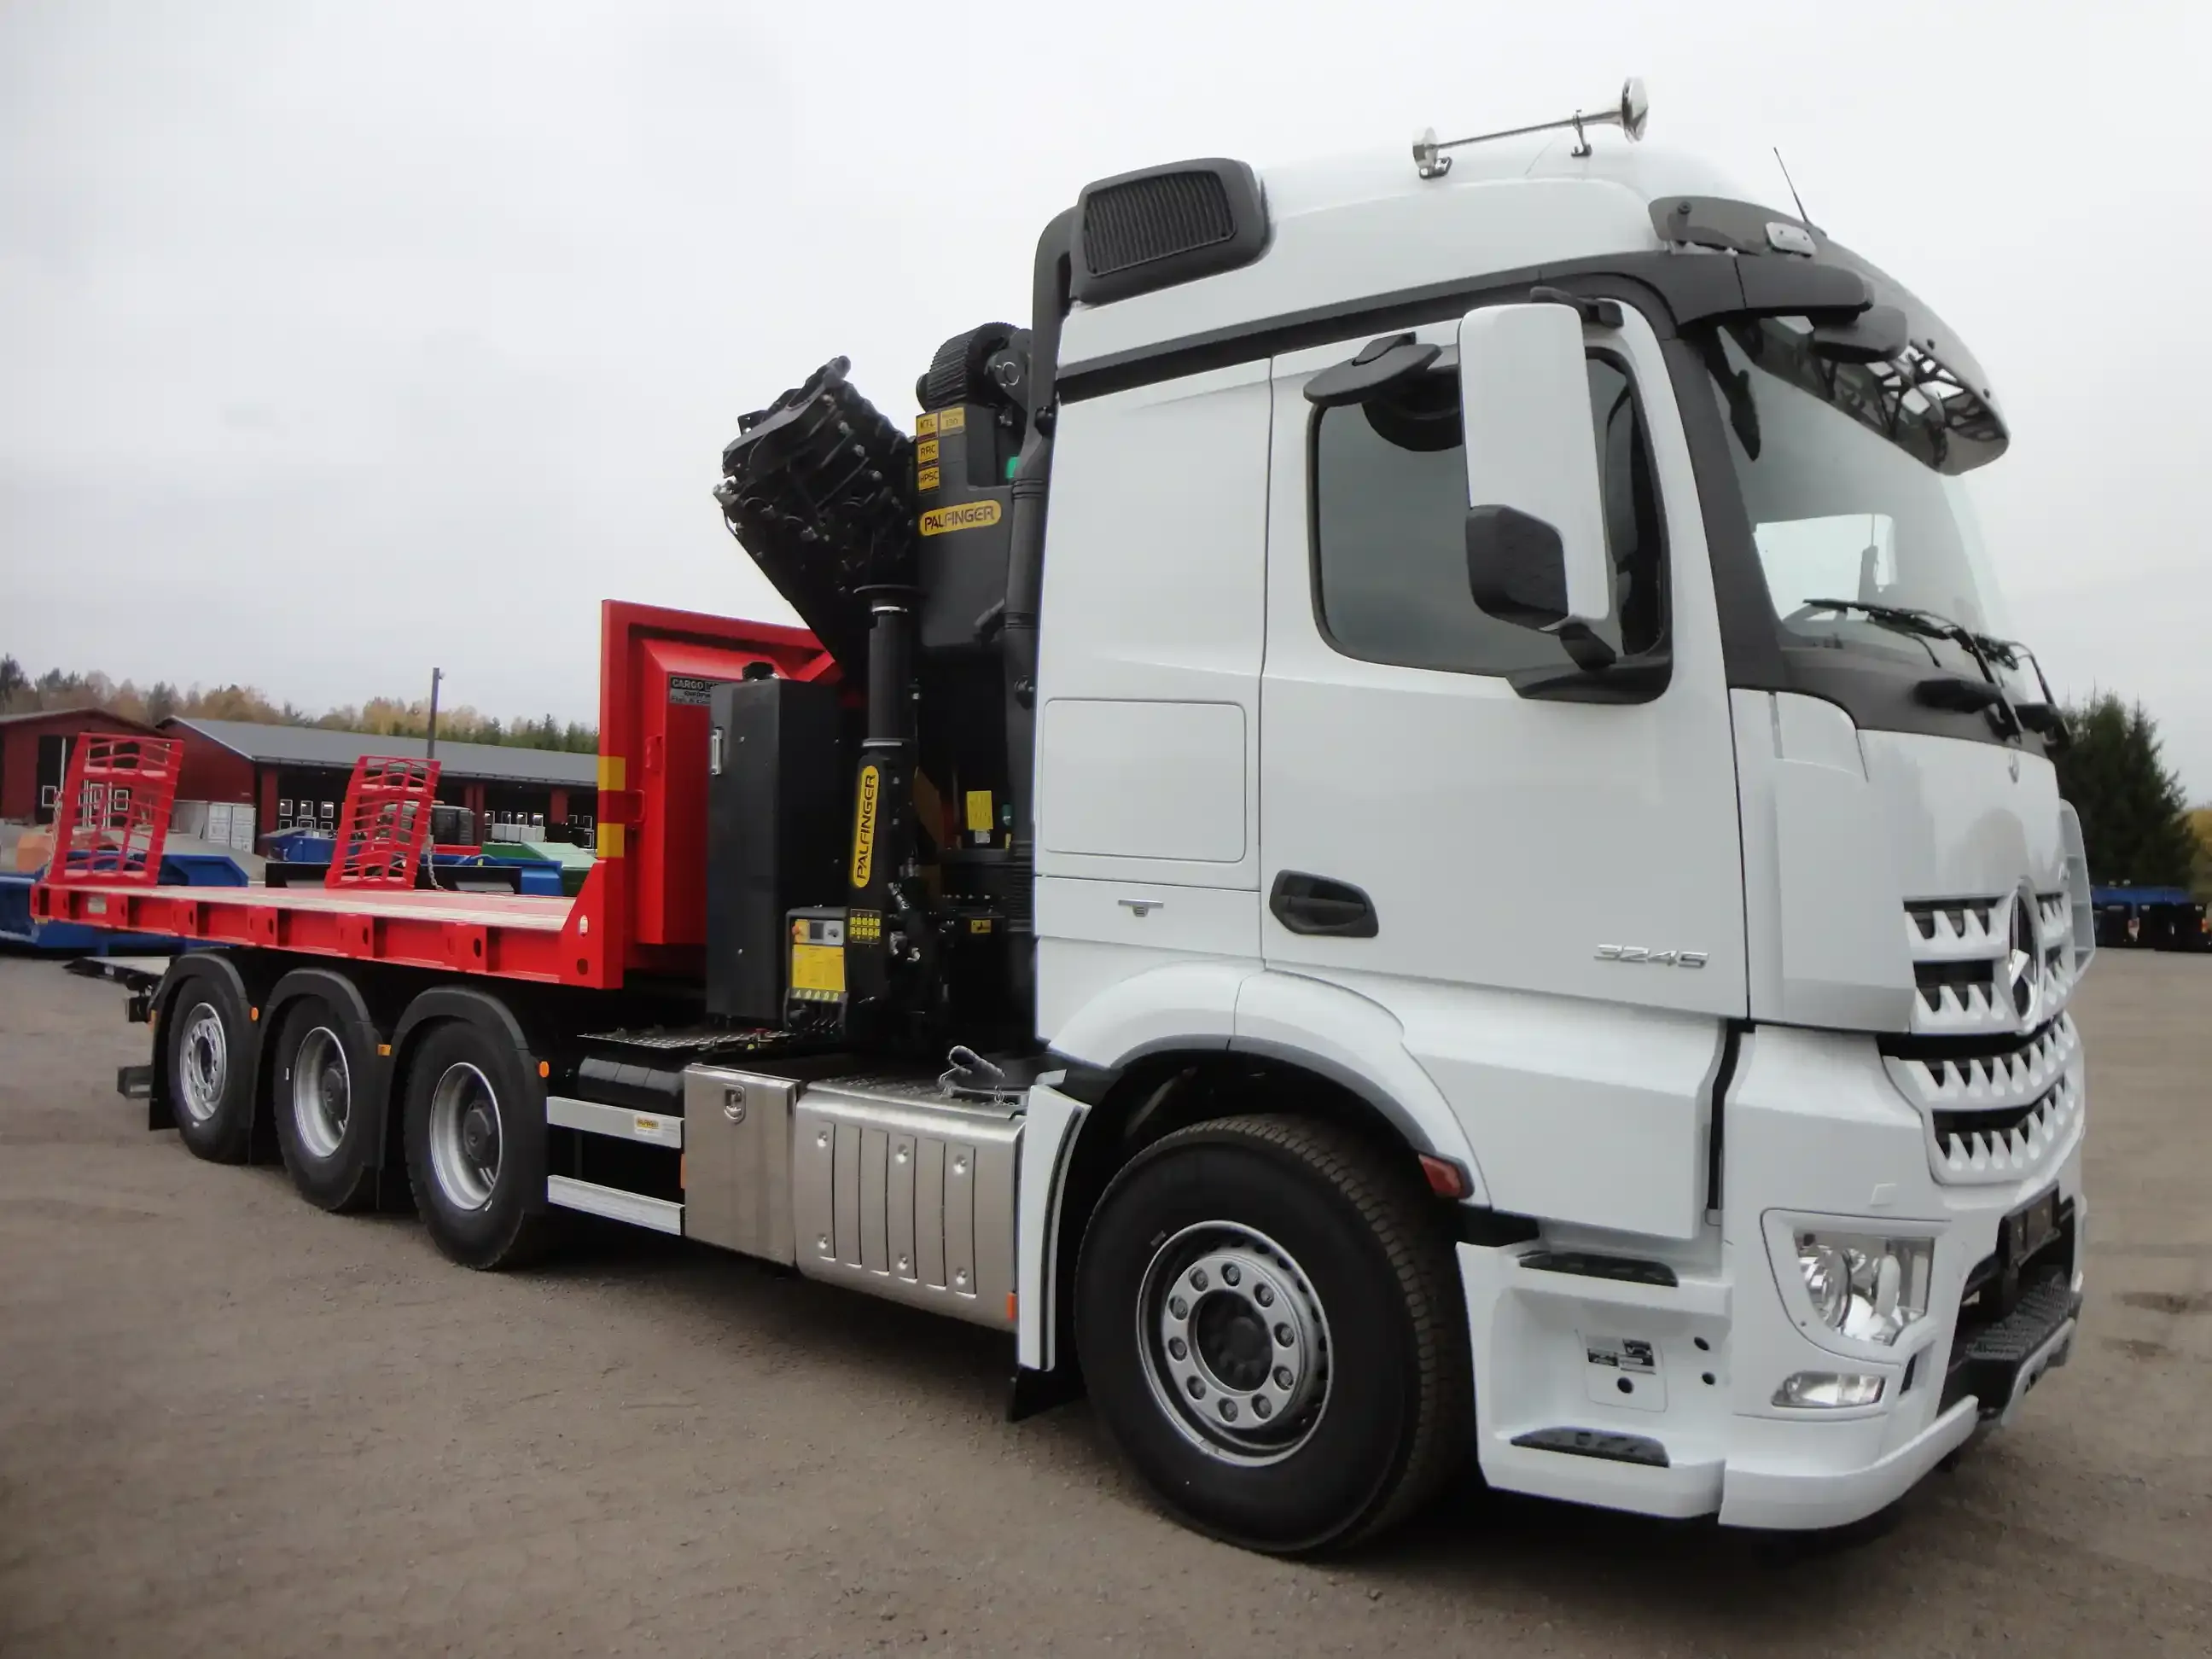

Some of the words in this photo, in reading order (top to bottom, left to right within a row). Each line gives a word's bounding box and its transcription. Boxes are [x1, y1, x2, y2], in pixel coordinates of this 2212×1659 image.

[924, 505, 995, 532] PALFINGER
[672, 678, 704, 690] CARGO
[857, 774, 876, 880] PALFINGER
[1593, 943, 1709, 969] 3245
